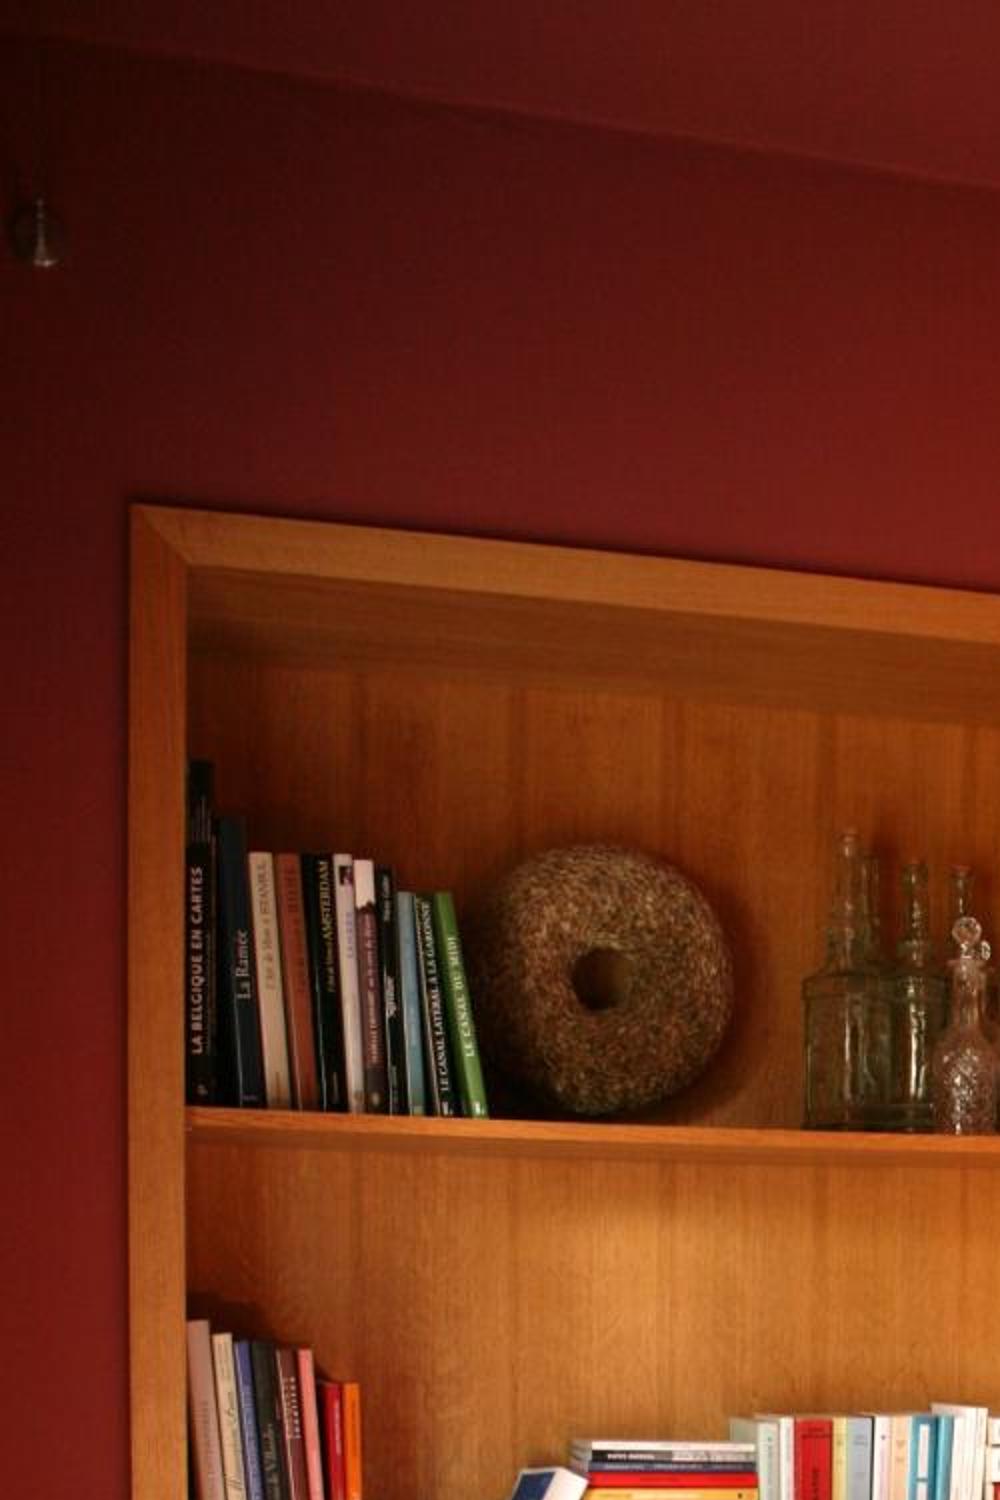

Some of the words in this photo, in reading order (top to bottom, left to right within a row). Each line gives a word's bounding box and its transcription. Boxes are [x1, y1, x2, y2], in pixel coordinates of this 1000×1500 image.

[191, 867, 204, 924] CARTES
[191, 929, 204, 949] EN
[191, 960, 205, 1034] BELGIQUE
[455, 995, 474, 1039] CANAL
[192, 1036, 204, 1055] LA
